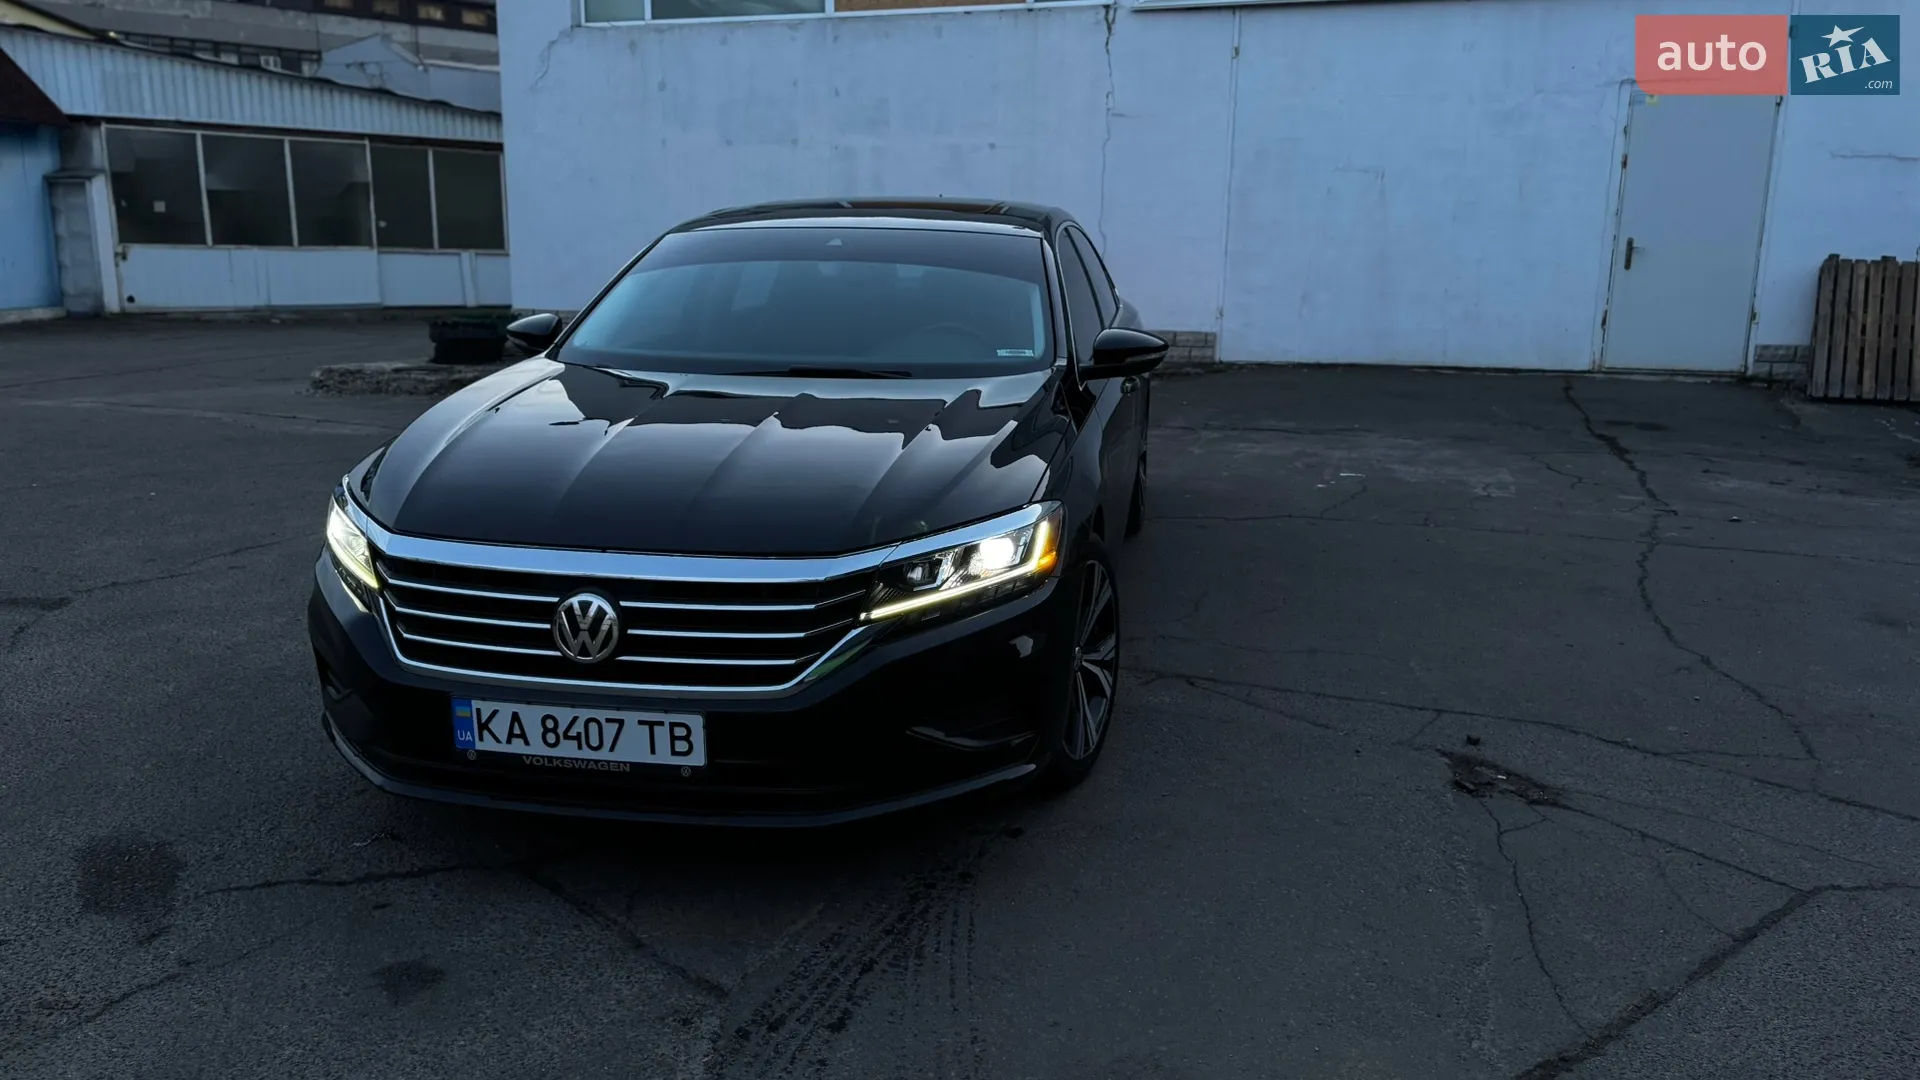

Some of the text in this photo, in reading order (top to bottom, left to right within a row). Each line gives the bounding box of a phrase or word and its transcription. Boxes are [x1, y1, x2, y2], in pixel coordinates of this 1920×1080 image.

[457, 730, 473, 742] UA
[475, 707, 694, 757] KA 8407 TB
[522, 755, 630, 772] VOLKSWAGEN
